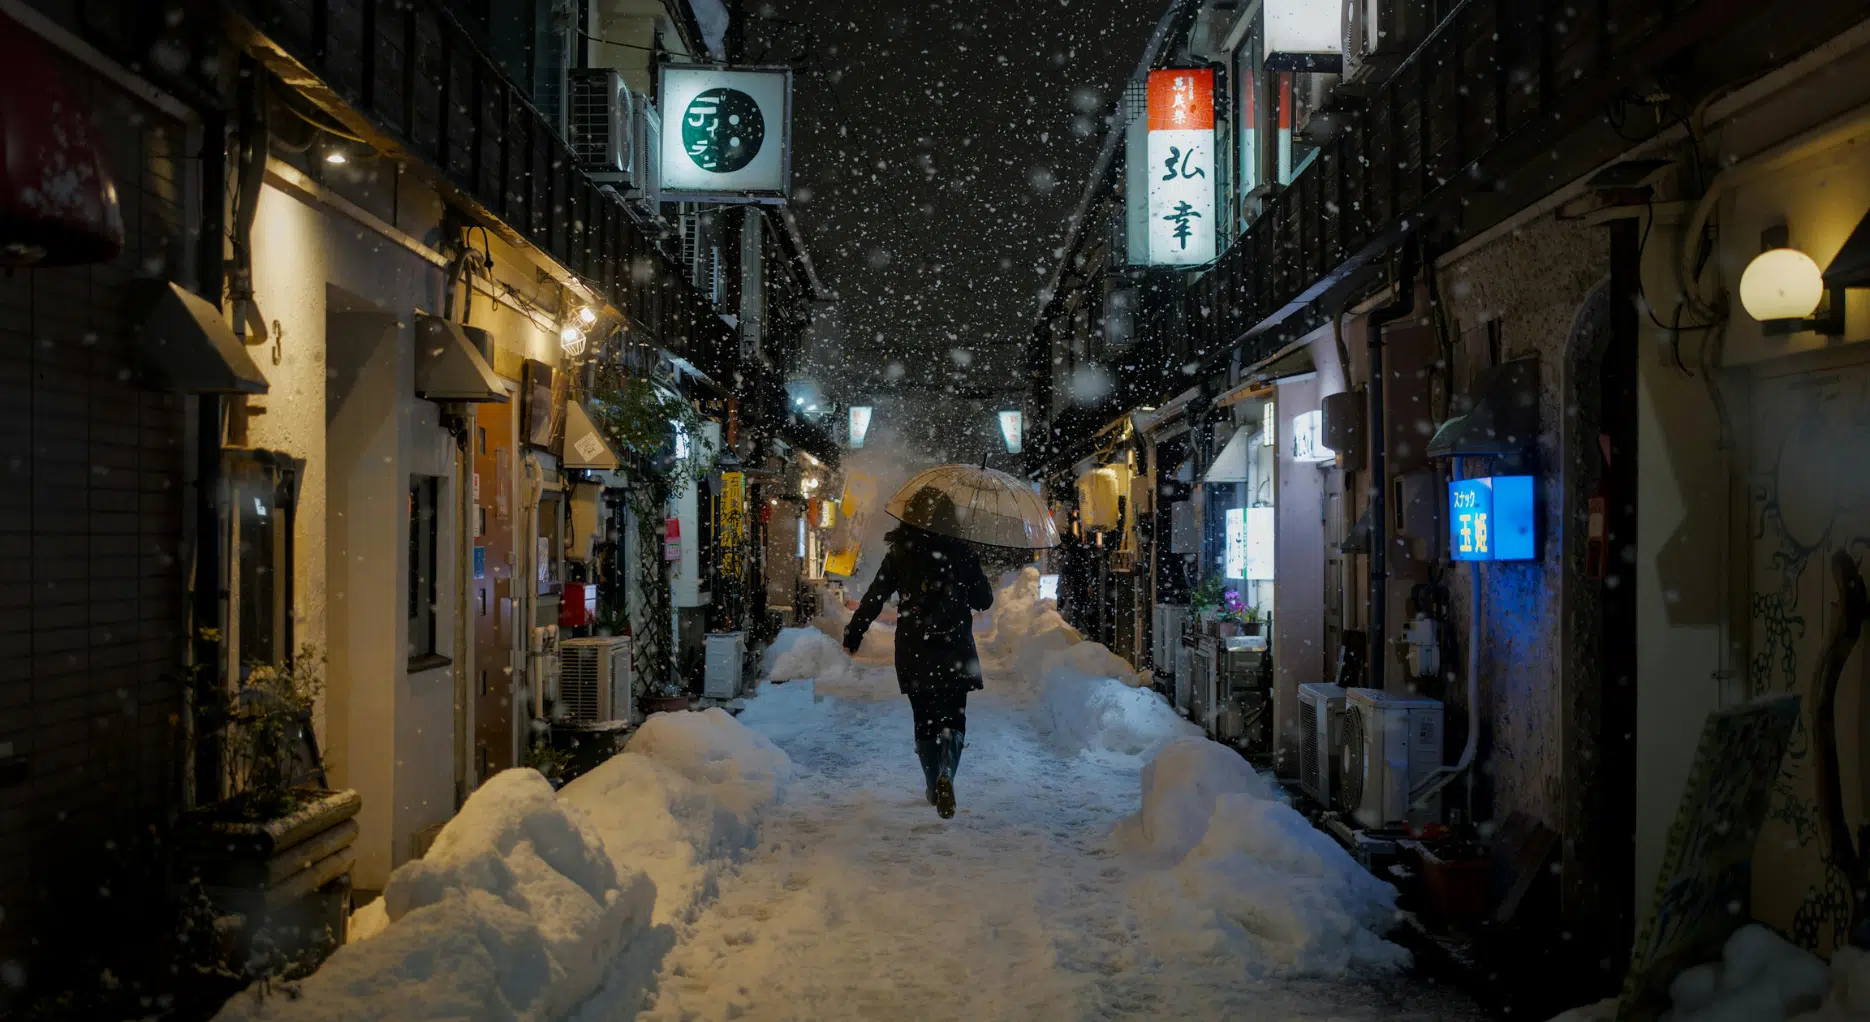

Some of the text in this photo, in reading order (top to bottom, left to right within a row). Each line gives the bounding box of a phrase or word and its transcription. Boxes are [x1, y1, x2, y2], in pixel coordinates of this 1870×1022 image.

[1162, 146, 1205, 250] 弘幸
[1453, 490, 1475, 508] スナック
[1459, 512, 1488, 553] 玉姫
